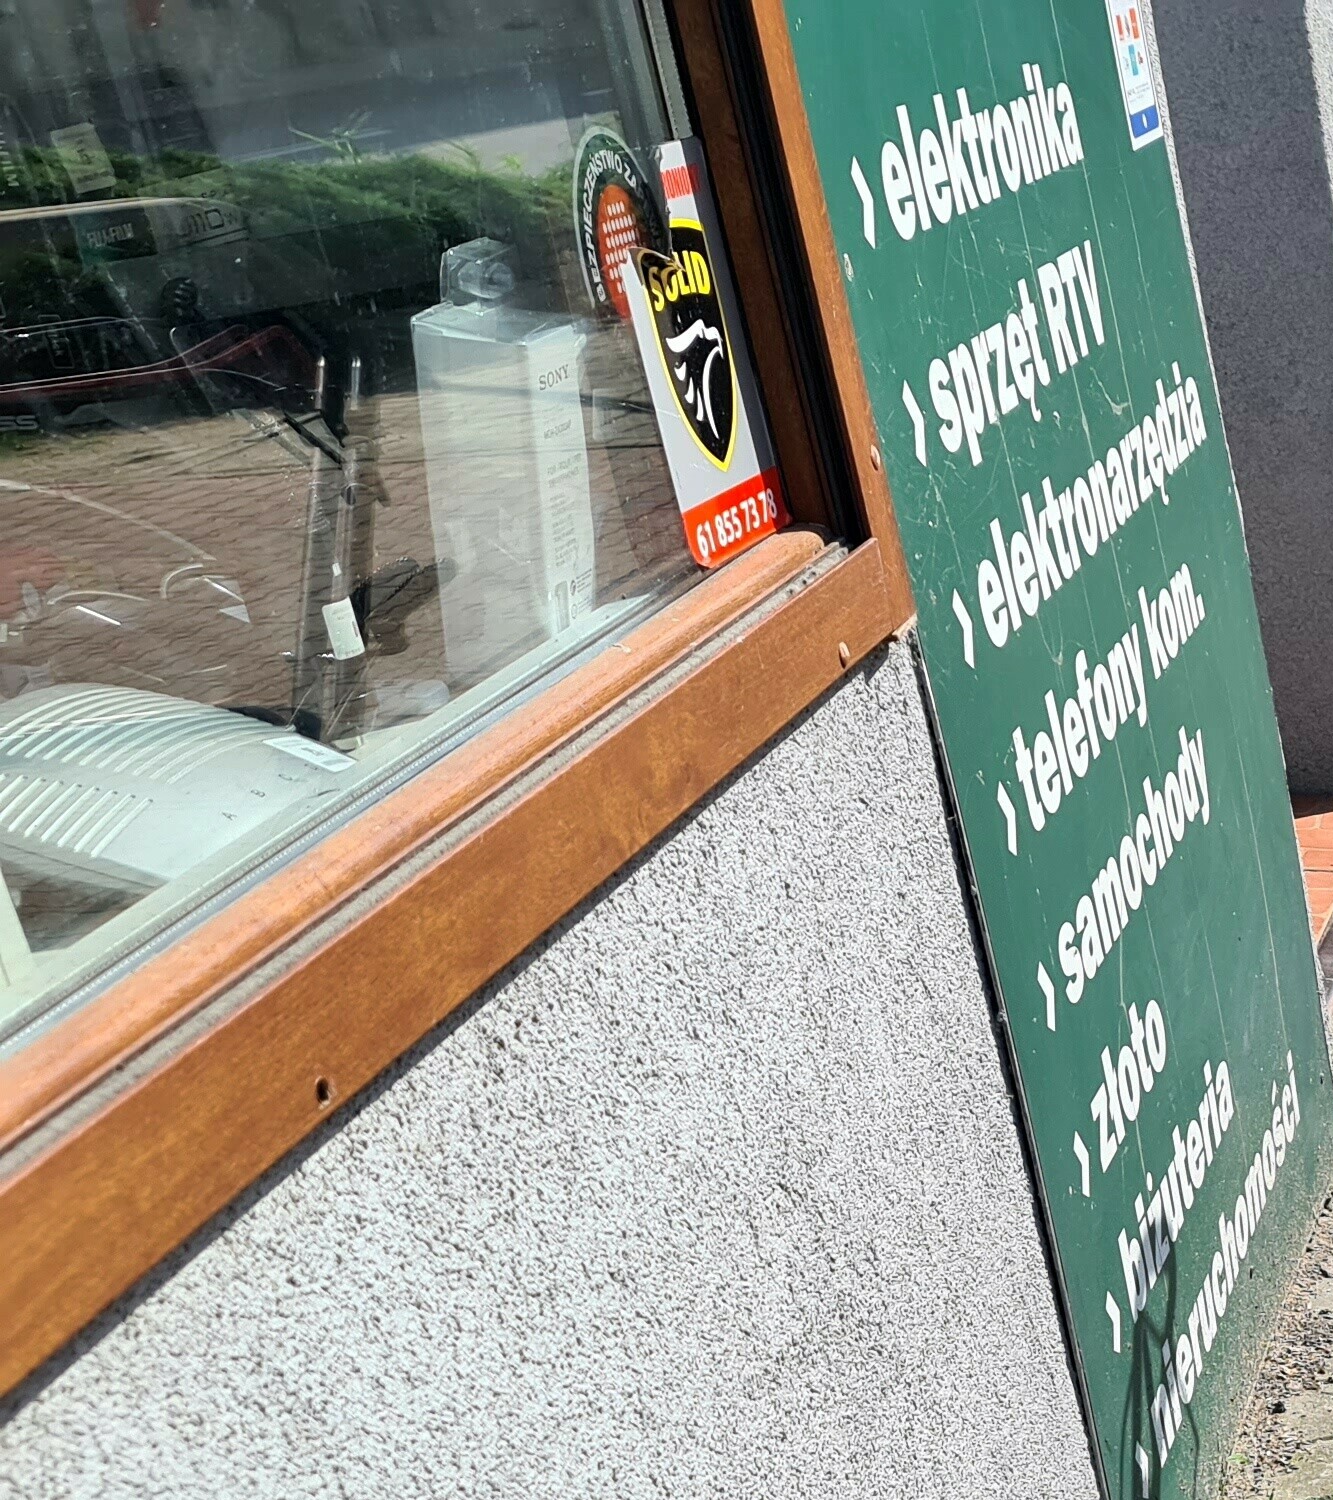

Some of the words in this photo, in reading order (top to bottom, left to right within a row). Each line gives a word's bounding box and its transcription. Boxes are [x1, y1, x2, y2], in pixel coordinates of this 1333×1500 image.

[880, 62, 1085, 241] elektronika
[538, 364, 569, 391] SONY
[647, 250, 711, 312] SOLID
[928, 278, 1050, 466] sprzęt
[1047, 240, 1107, 375] RTV
[696, 520, 716, 559] 61
[714, 506, 743, 547] 855
[740, 496, 760, 533] 73
[757, 488, 778, 523] 78
[977, 360, 1207, 648] elektronarzędzia
[1013, 622, 1146, 832] telefony
[1142, 562, 1206, 680] kom.
[1056, 726, 1211, 1005] samochody
[1092, 998, 1167, 1174] złoto
[1117, 1059, 1236, 1323] biżuteria
[1150, 1050, 1300, 1469] nieruchomości
